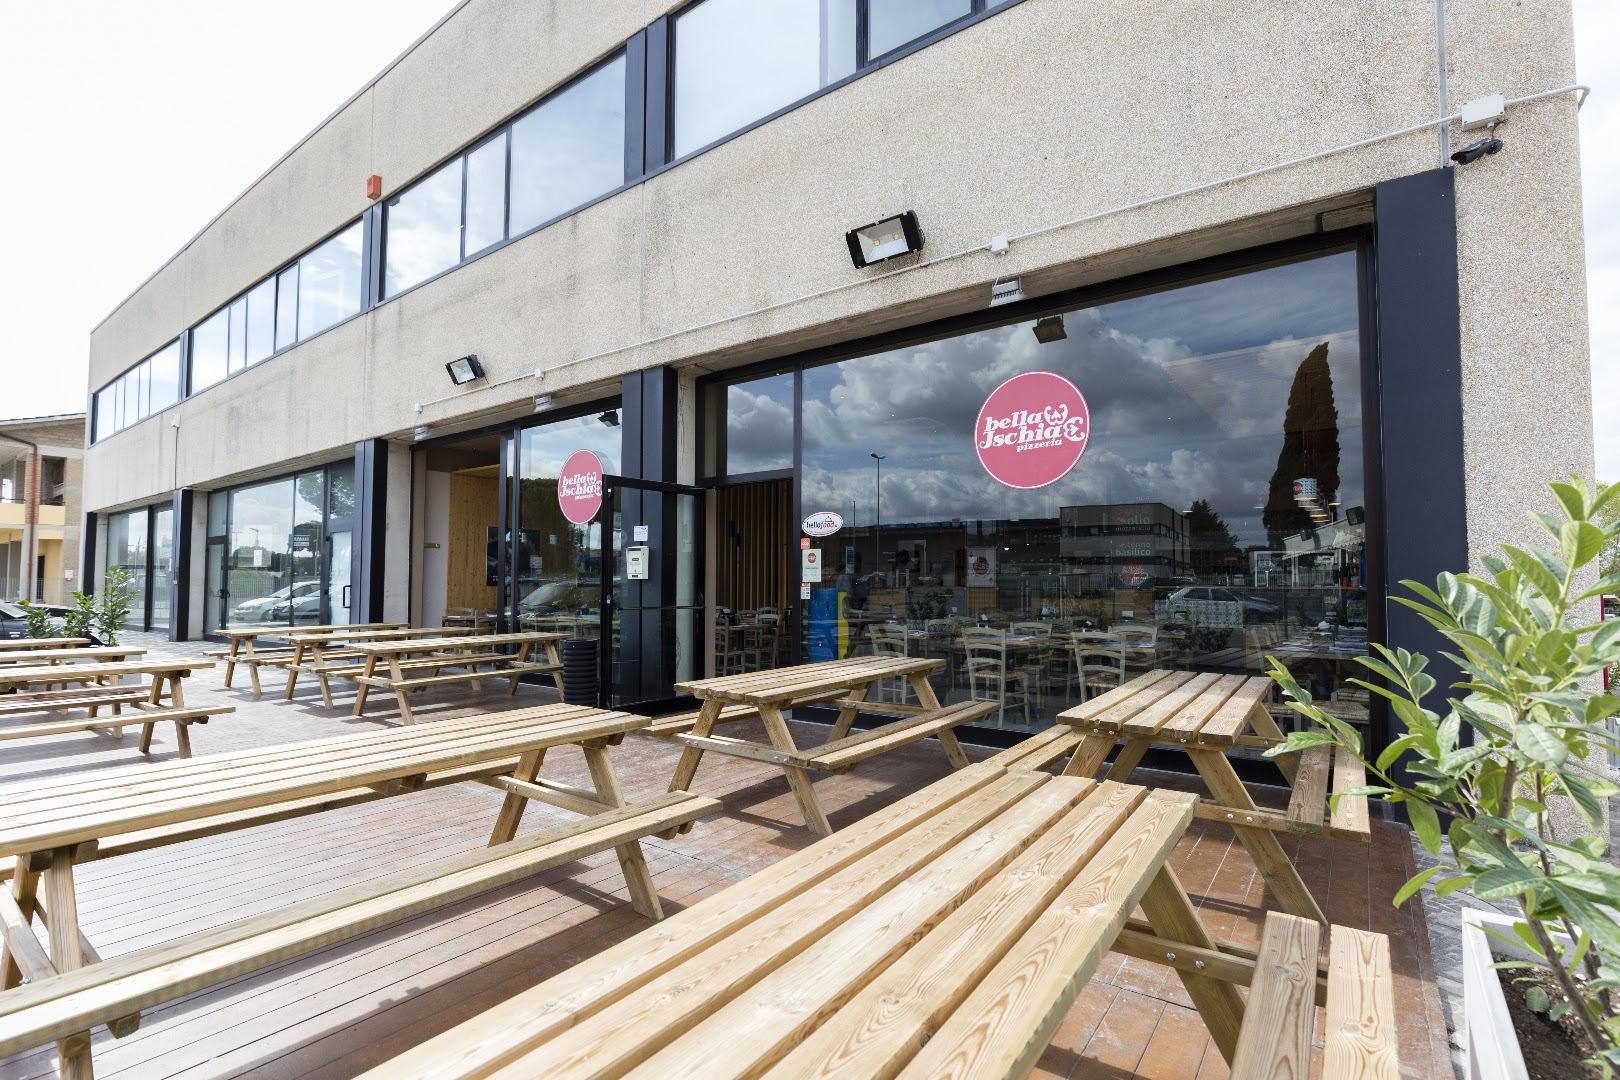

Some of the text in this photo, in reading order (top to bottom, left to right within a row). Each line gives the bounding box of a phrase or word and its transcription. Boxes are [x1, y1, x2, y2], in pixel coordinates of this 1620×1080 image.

[984, 410, 1043, 432] bella
[1016, 439, 1063, 453] pizzeria
[562, 473, 587, 486] bella
[1115, 547, 1151, 556] basilico
